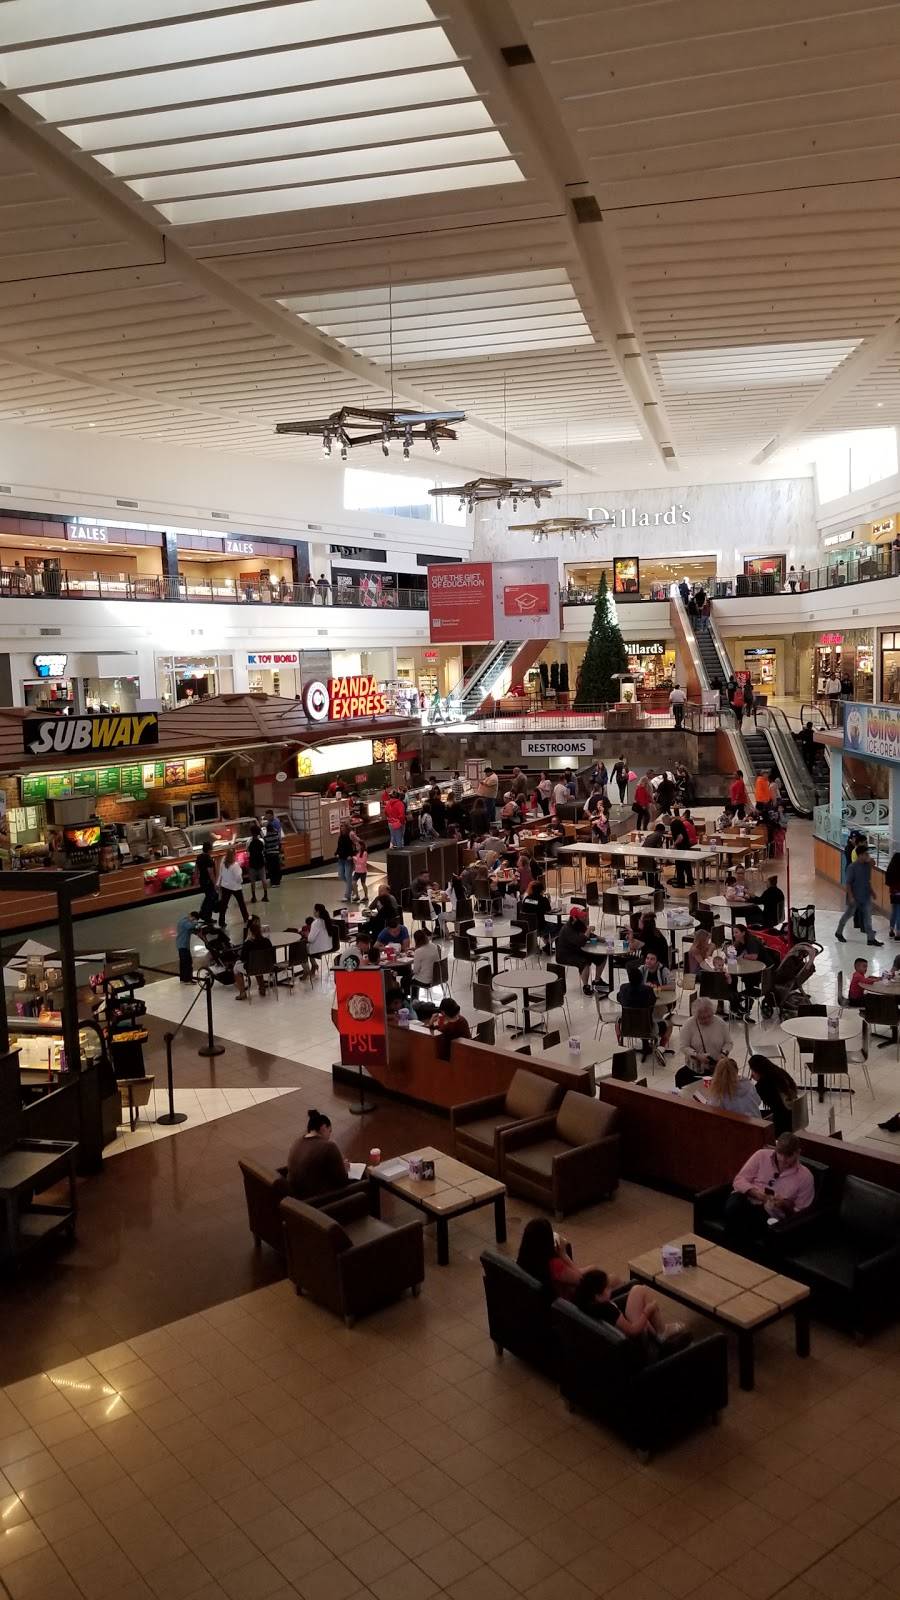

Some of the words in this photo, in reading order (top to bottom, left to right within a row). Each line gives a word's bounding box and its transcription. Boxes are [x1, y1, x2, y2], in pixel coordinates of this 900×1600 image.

[585, 504, 691, 528] Dillard's
[71, 526, 106, 541] ZALES
[227, 541, 254, 554] ZALES
[443, 580, 485, 588] EDUCATION
[258, 655, 271, 664] TOY
[273, 654, 298, 663] WORLD
[332, 677, 377, 699] PANDA
[333, 695, 387, 719] EXPRESS
[29, 714, 158, 754] SUBWAY
[528, 742, 586, 753] RESTROOMS
[349, 1033, 377, 1052] PSL
